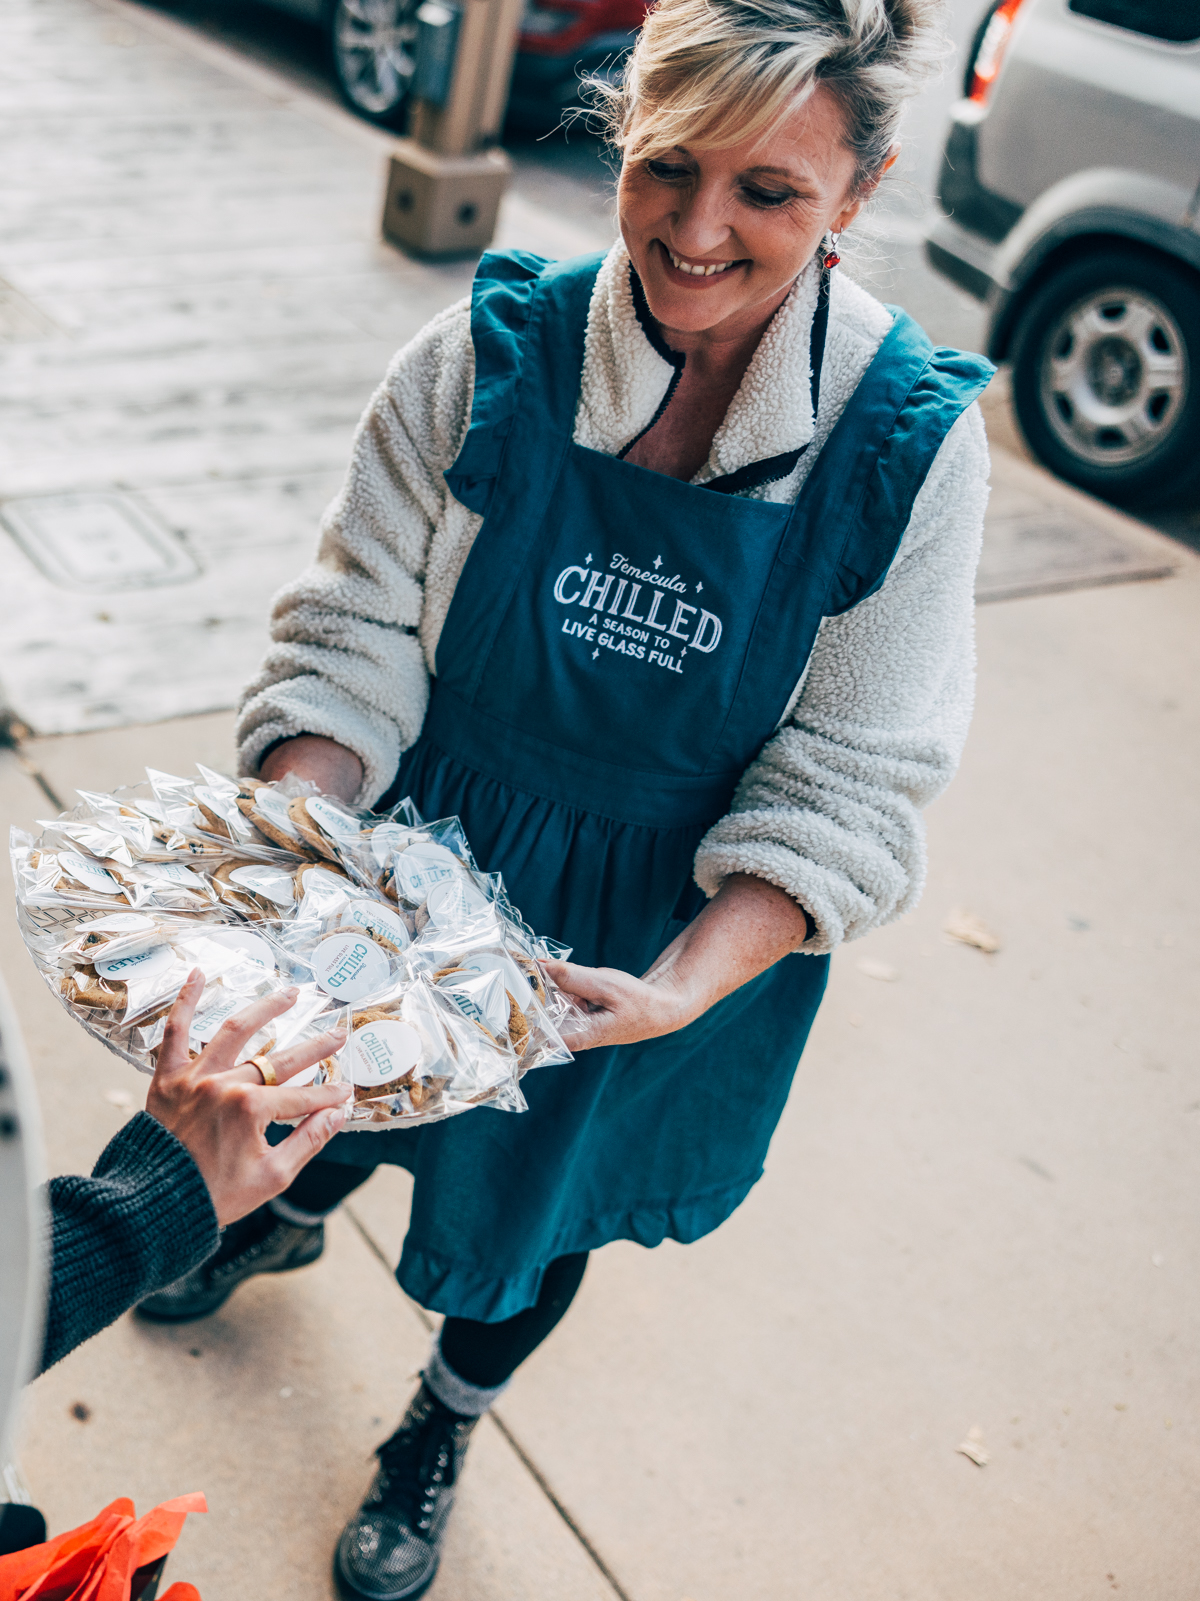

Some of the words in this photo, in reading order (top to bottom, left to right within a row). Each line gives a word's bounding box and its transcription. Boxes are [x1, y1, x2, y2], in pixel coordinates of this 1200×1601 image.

[610, 553, 687, 593] Temecula
[553, 565, 723, 654] CHILLED
[588, 613, 598, 625] A
[602, 618, 650, 643] SEASON
[654, 635, 670, 649] TO
[561, 618, 597, 642] LIVE
[597, 632, 646, 659] GLASS
[648, 650, 683, 674] FULL
[327, 943, 368, 988] CHILLED
[360, 1032, 393, 1076] CHILLED
